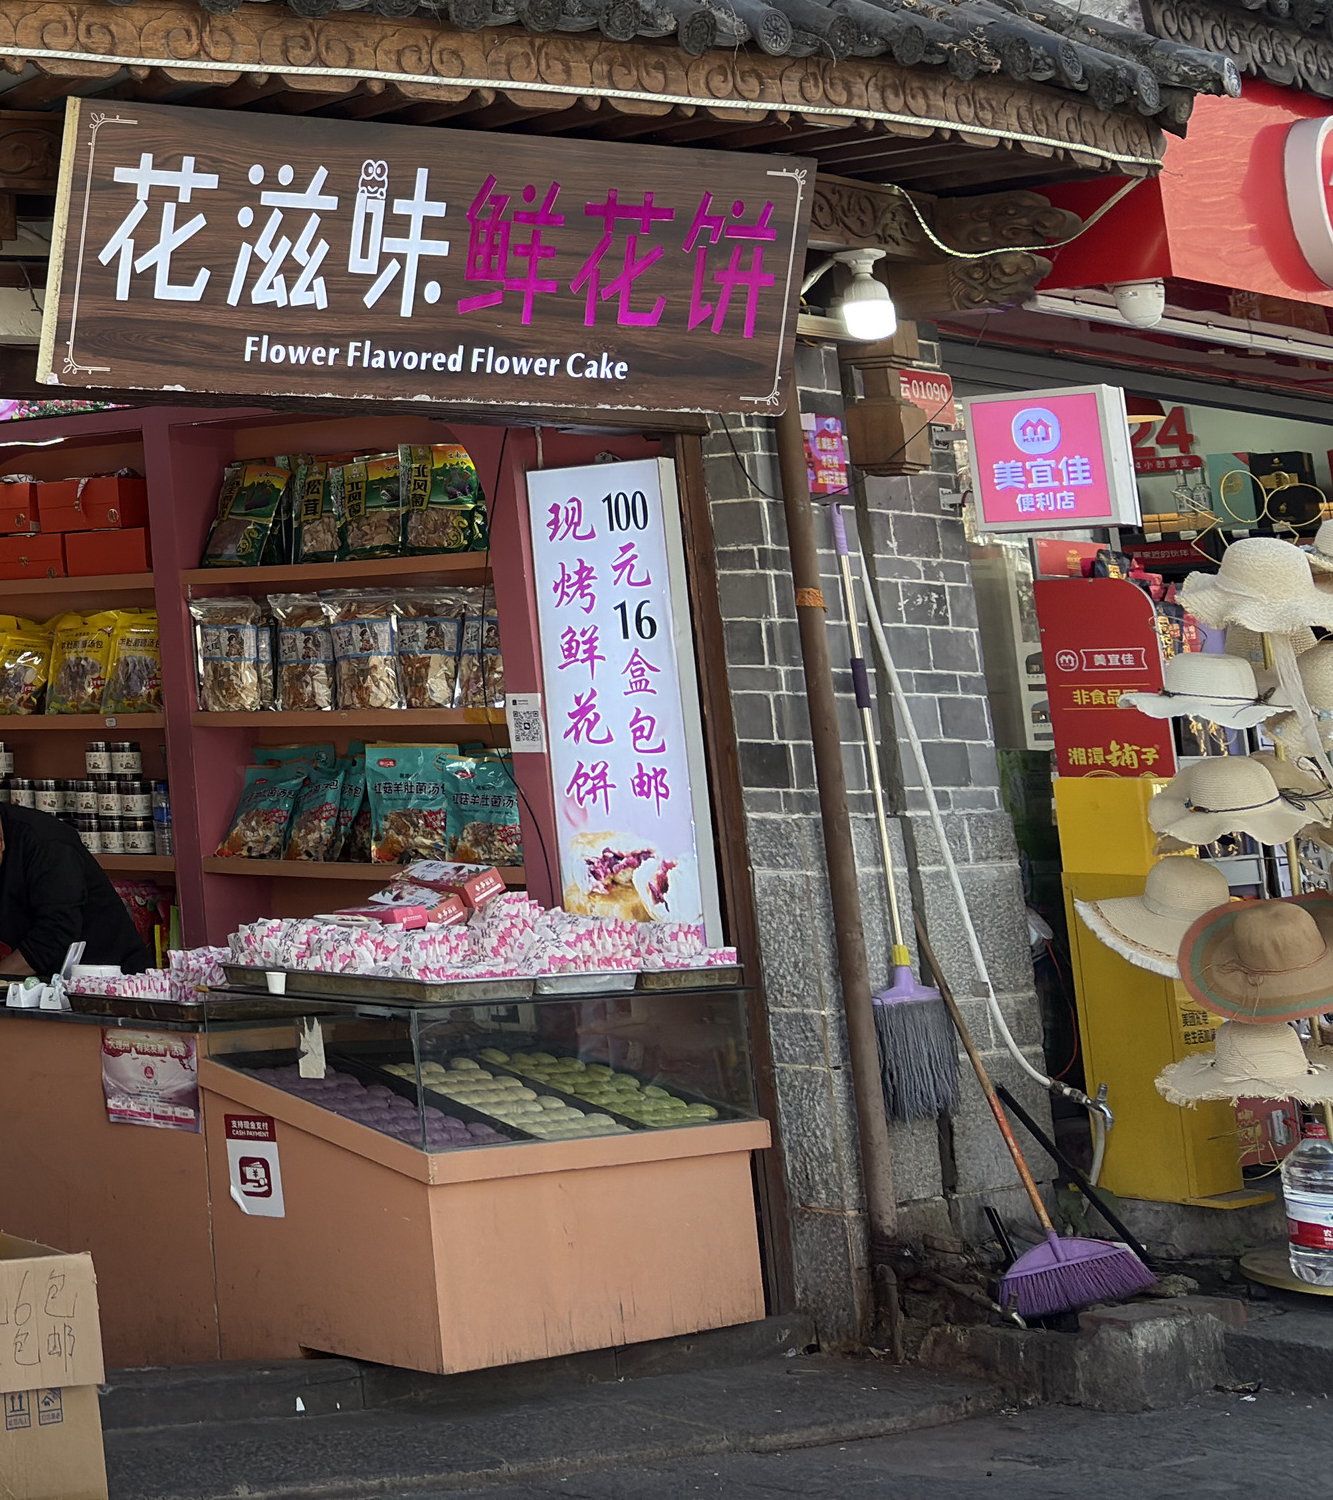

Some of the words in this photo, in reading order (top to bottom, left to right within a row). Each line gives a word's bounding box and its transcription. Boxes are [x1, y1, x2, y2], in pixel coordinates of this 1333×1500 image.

[245, 336, 340, 368] Flower
[347, 339, 464, 373] Flavored
[471, 345, 561, 377] Flower
[566, 352, 628, 381] Cake
[993, 455, 1093, 491] 美宜佳
[1016, 491, 1076, 513] 便利店
[548, 496, 616, 816] 现烤鲜花饼
[1094, 653, 1135, 666] 美宜佳
[1068, 740, 1156, 769] 湘潭铺子
